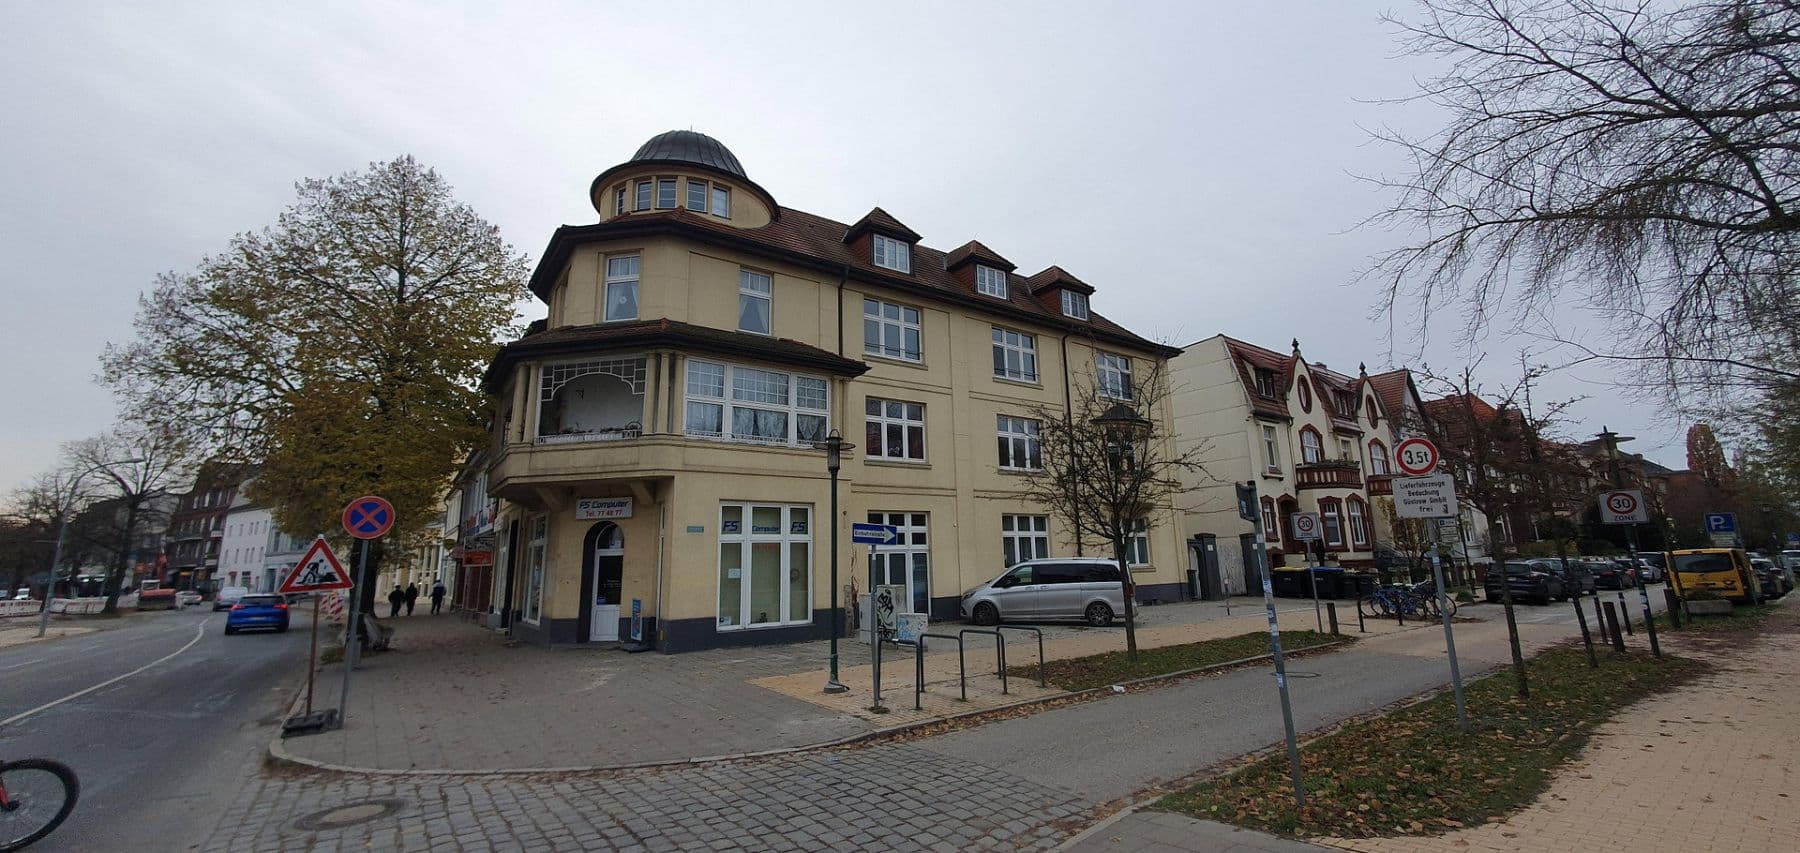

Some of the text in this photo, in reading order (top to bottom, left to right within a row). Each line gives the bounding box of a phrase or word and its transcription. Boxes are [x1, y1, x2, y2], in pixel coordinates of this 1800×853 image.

[1399, 481, 1446, 490] Lieferfahrzeuge
[1407, 489, 1440, 497] Bedachung
[579, 500, 629, 510] FS Computer
[1612, 498, 1631, 509] 30
[723, 520, 739, 531] FS
[791, 521, 807, 531] FS
[1300, 519, 1311, 528] 30
[1710, 516, 1725, 530] P
